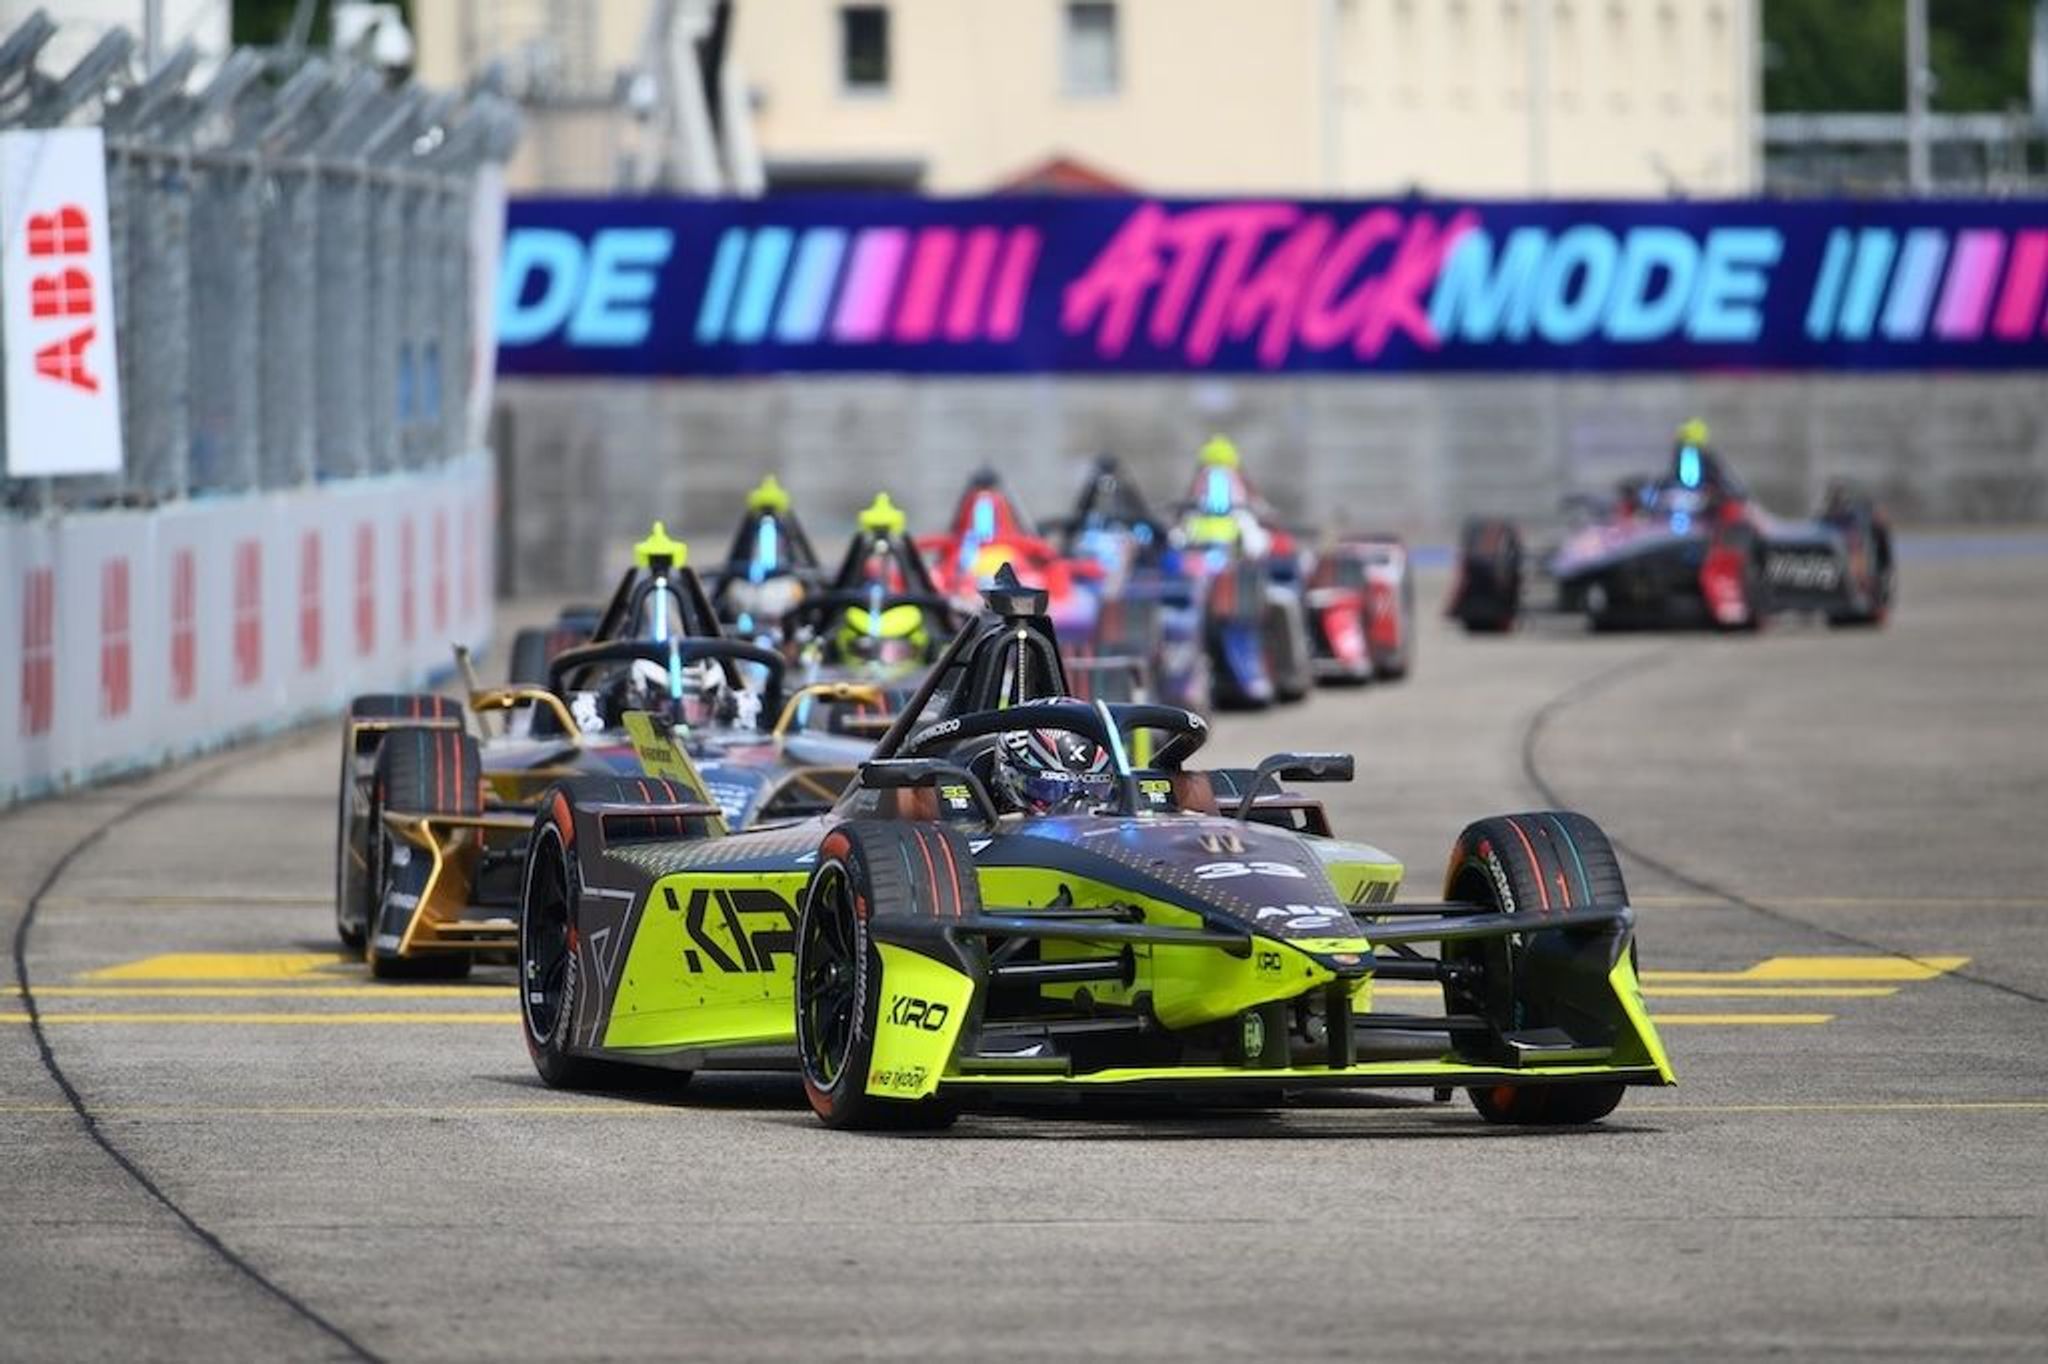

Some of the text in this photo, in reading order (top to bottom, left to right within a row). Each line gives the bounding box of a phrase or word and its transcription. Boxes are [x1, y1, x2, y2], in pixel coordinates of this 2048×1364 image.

[26, 205, 98, 391] ABB
[1061, 201, 1785, 367] ATTACK MODE
[1193, 862, 1306, 879] 33
[664, 888, 806, 973] KIR
[887, 995, 949, 1032] KIRO
